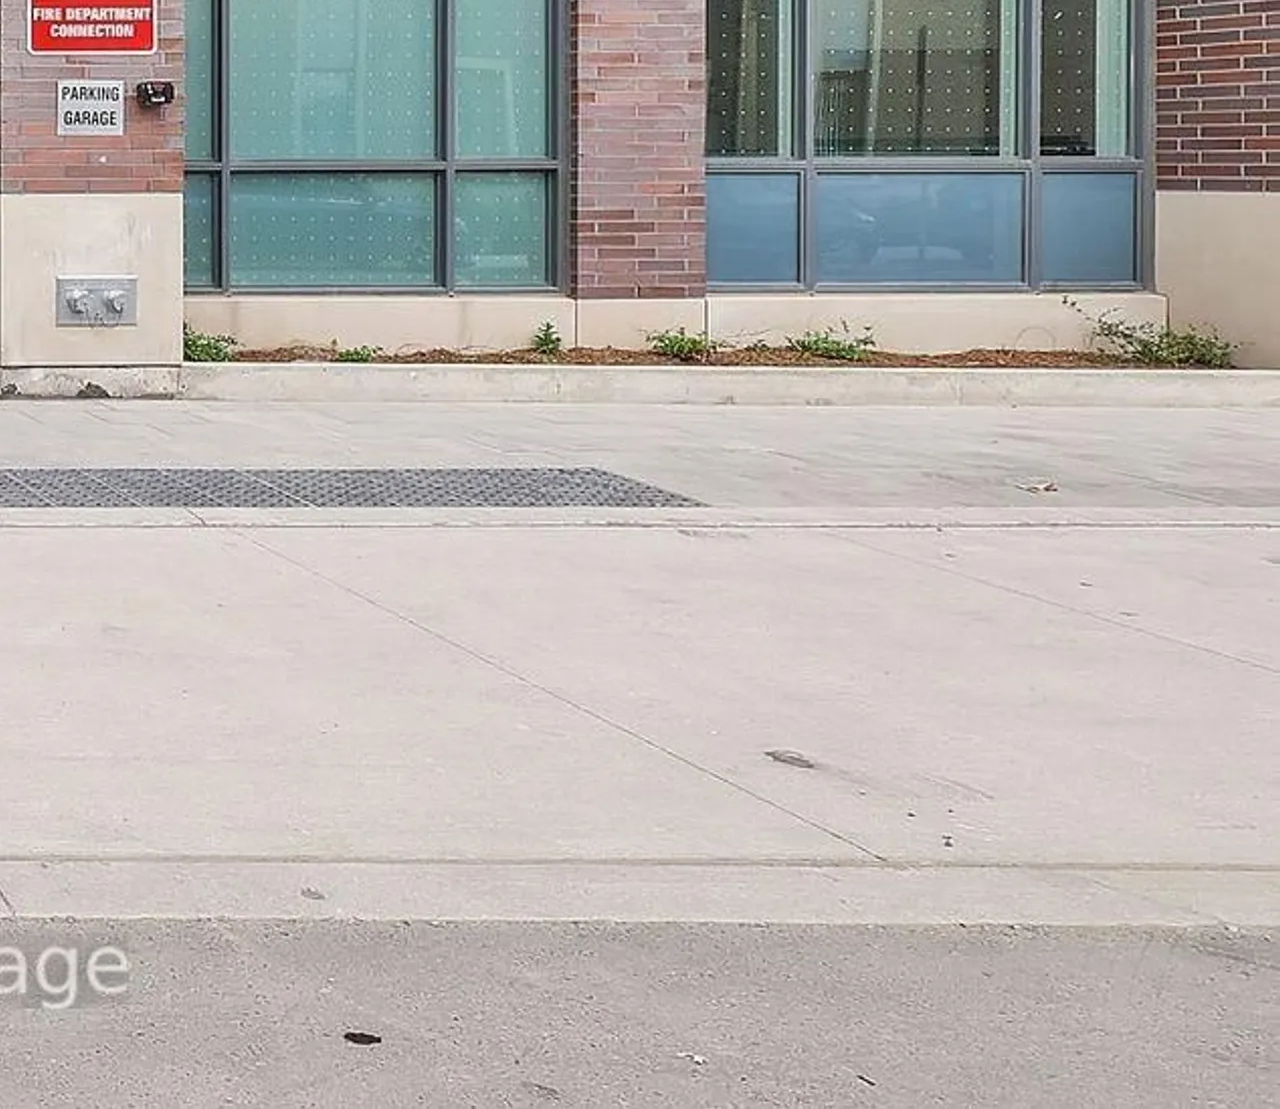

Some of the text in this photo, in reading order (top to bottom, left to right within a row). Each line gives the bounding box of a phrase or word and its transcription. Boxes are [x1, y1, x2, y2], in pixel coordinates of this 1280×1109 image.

[32, 7, 152, 21] FIRE DEPARTMENT
[49, 23, 135, 38] CONNECTION
[61, 86, 120, 102] PARKING
[63, 110, 117, 126] GARAGE
